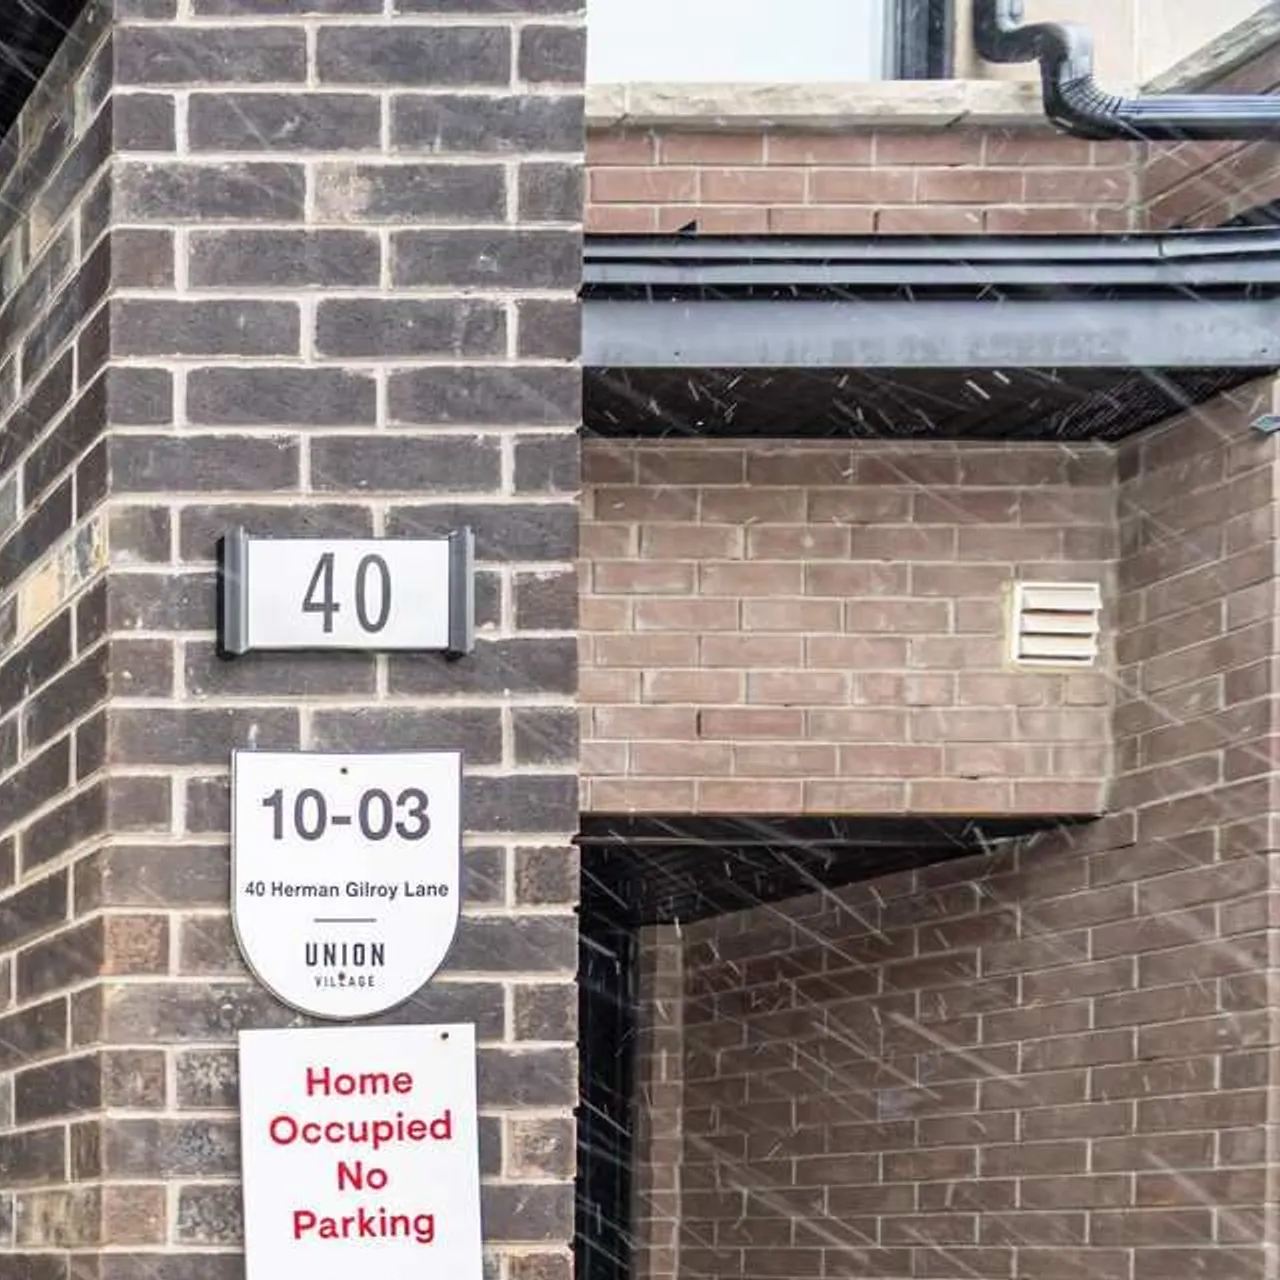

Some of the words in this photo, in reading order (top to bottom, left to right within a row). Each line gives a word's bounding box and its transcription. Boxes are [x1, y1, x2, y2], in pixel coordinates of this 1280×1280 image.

[302, 552, 392, 634] 40
[262, 787, 431, 841] 10-03
[244, 881, 266, 898] 40
[271, 880, 340, 898] Herman
[345, 880, 399, 902] Gilroy
[404, 881, 449, 898] Lane
[305, 942, 386, 967] UNION
[306, 1066, 414, 1097] Home
[269, 1109, 453, 1150] Occupied
[337, 1160, 388, 1191] No
[293, 1207, 435, 1244] Parking
